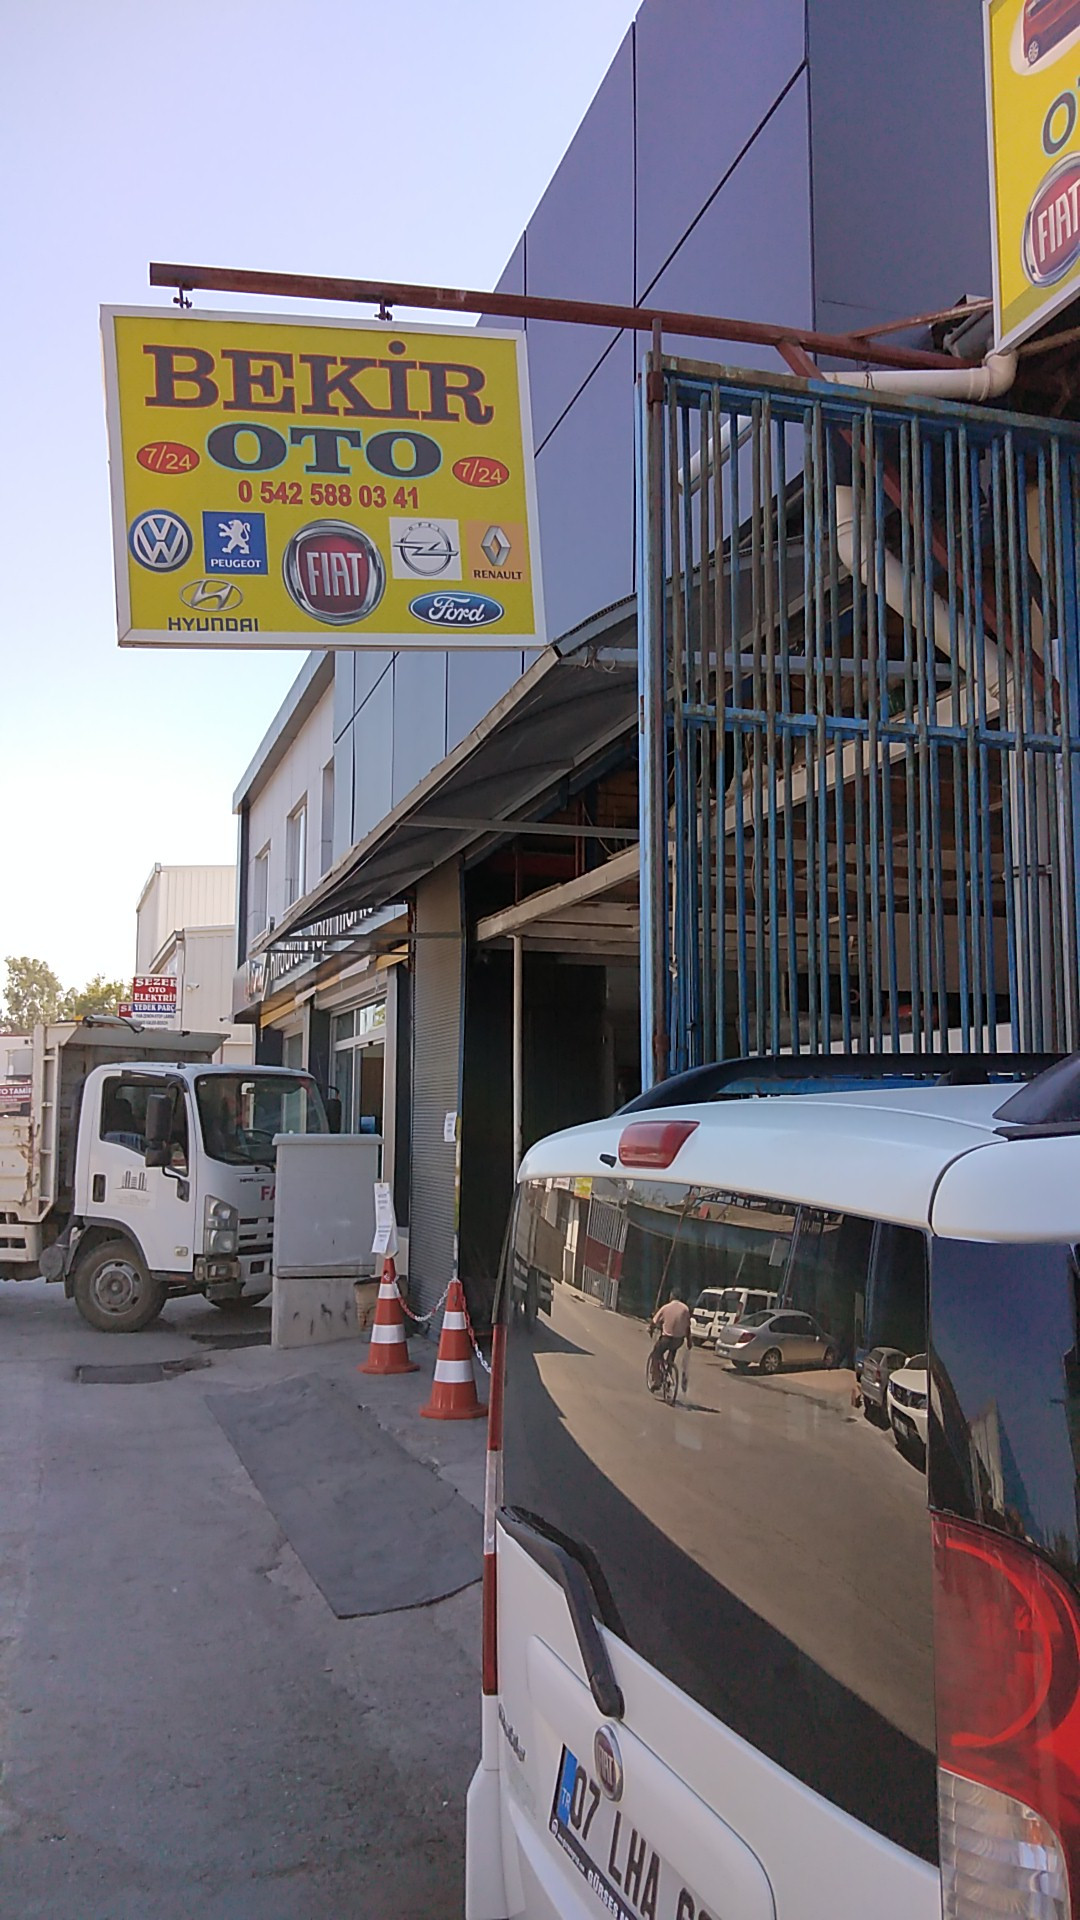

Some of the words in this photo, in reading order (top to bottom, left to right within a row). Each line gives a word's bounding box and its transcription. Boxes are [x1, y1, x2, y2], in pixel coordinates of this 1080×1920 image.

[1041, 76, 1080, 157] O
[1037, 179, 1080, 262] FIAT
[142, 340, 495, 425] BEKİR
[144, 445, 193, 470] 7/24
[205, 422, 443, 479] OTO
[458, 461, 503, 485] 7/24
[238, 480, 253, 503] 0
[260, 481, 303, 505] 542
[310, 483, 352, 507] 588
[359, 485, 387, 508] 03
[393, 486, 420, 510] 41
[133, 513, 189, 569] VW
[210, 558, 262, 570] PEUGEOT
[305, 551, 364, 597] FIAT
[473, 569, 523, 580] RENAULT
[428, 595, 485, 622] Ford
[168, 616, 259, 632] HYUNDAI
[134, 1003, 156, 1011] YEDEK
[562, 1787, 572, 1813] TR
[569, 1765, 600, 1841] 07
[608, 1810, 661, 1920] LHA
[587, 1869, 620, 1917] GÜRSES
